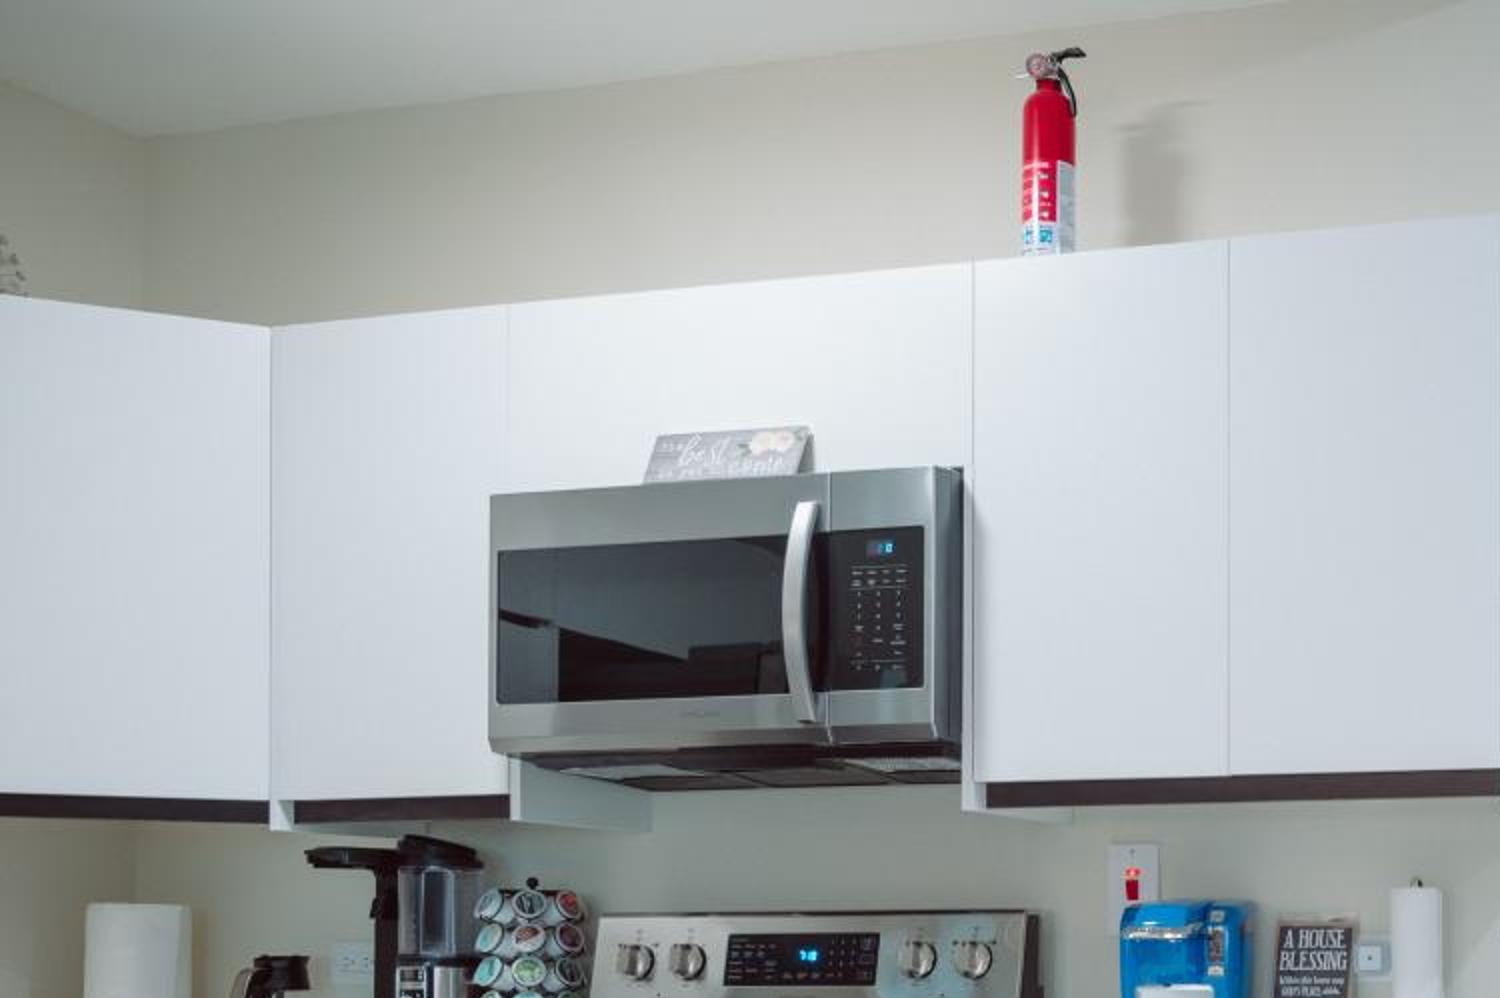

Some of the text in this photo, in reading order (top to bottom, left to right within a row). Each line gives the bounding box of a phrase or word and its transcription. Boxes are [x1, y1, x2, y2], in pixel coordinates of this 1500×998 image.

[1283, 929, 1346, 949] A HOUSE
[1280, 950, 1347, 971] BLESSING
